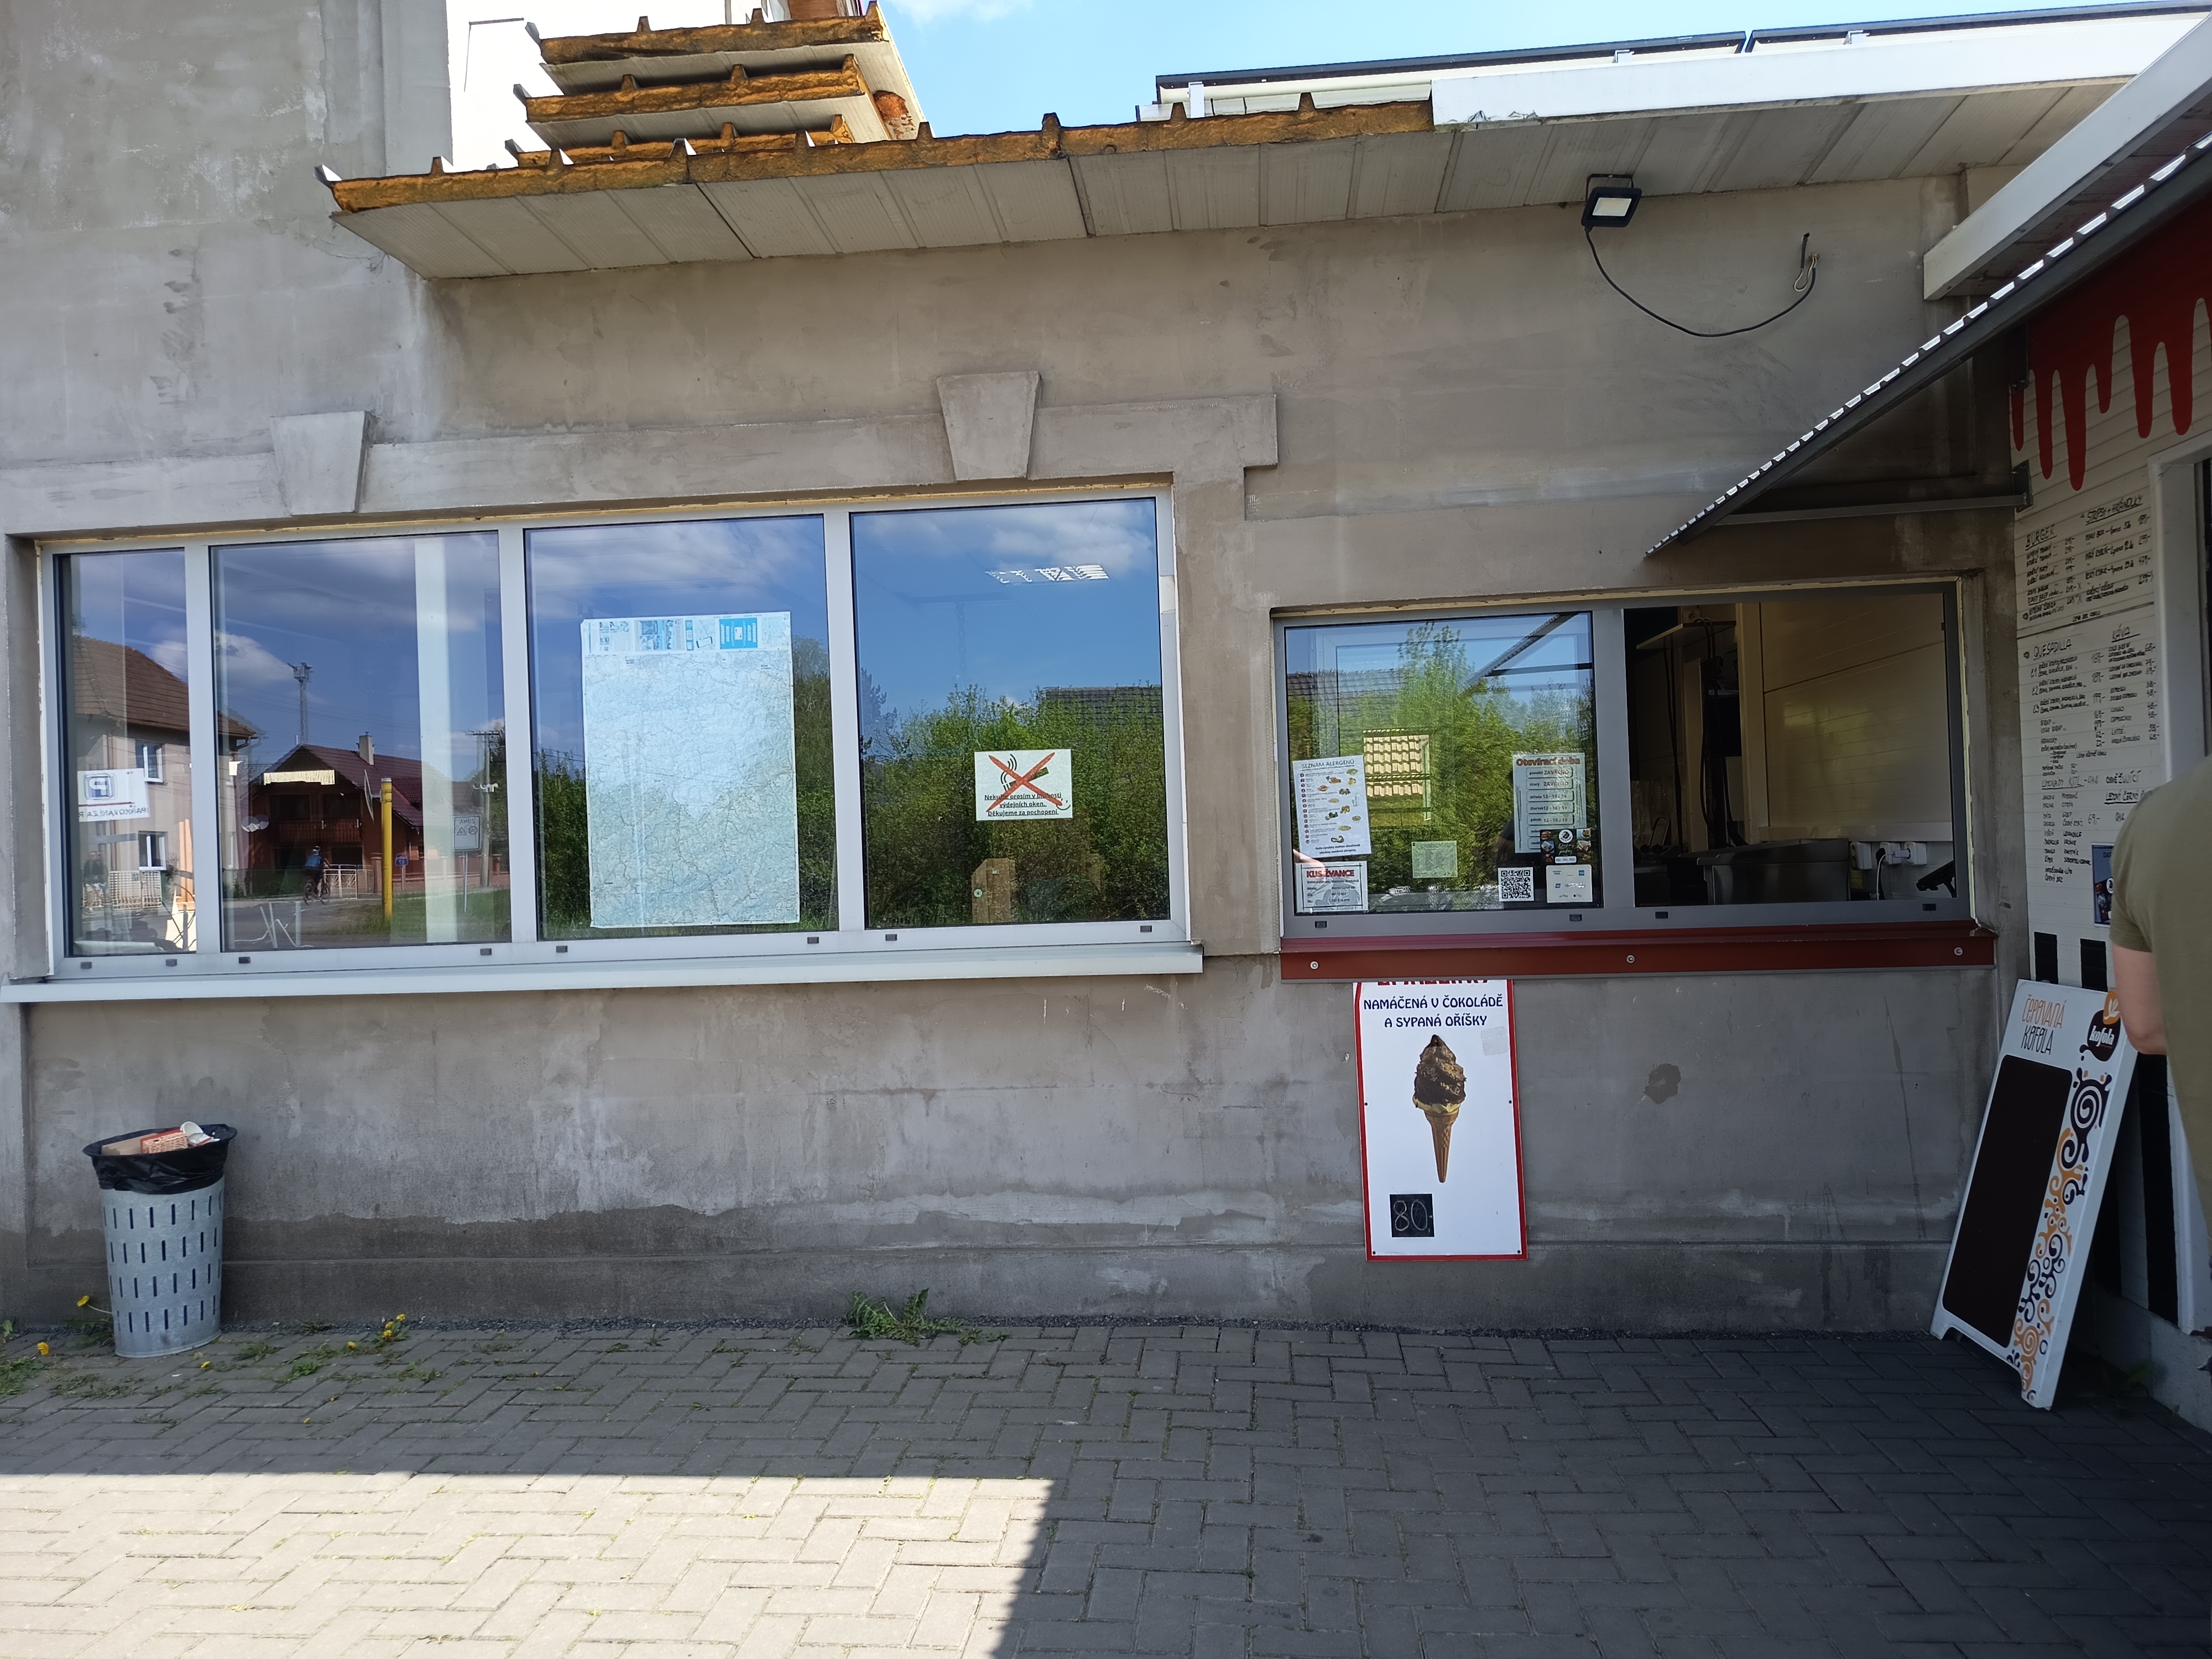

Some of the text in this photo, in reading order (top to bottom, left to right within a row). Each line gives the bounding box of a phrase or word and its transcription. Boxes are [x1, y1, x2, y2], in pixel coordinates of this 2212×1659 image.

[2025, 524, 2055, 548] BURGER
[2112, 623, 2131, 640] KÁVA
[2034, 639, 2073, 658] QUESADILLA
[1324, 868, 1355, 877] ŽVANCE
[1364, 994, 1504, 1010] NAMÁČENÁ V ČOKOLÁDĚ
[1384, 1013, 1488, 1027] A SYPANÁ OŘÍŠKY
[2021, 1025, 2054, 1055] KOFOLA
[2089, 1025, 2115, 1047] kofola
